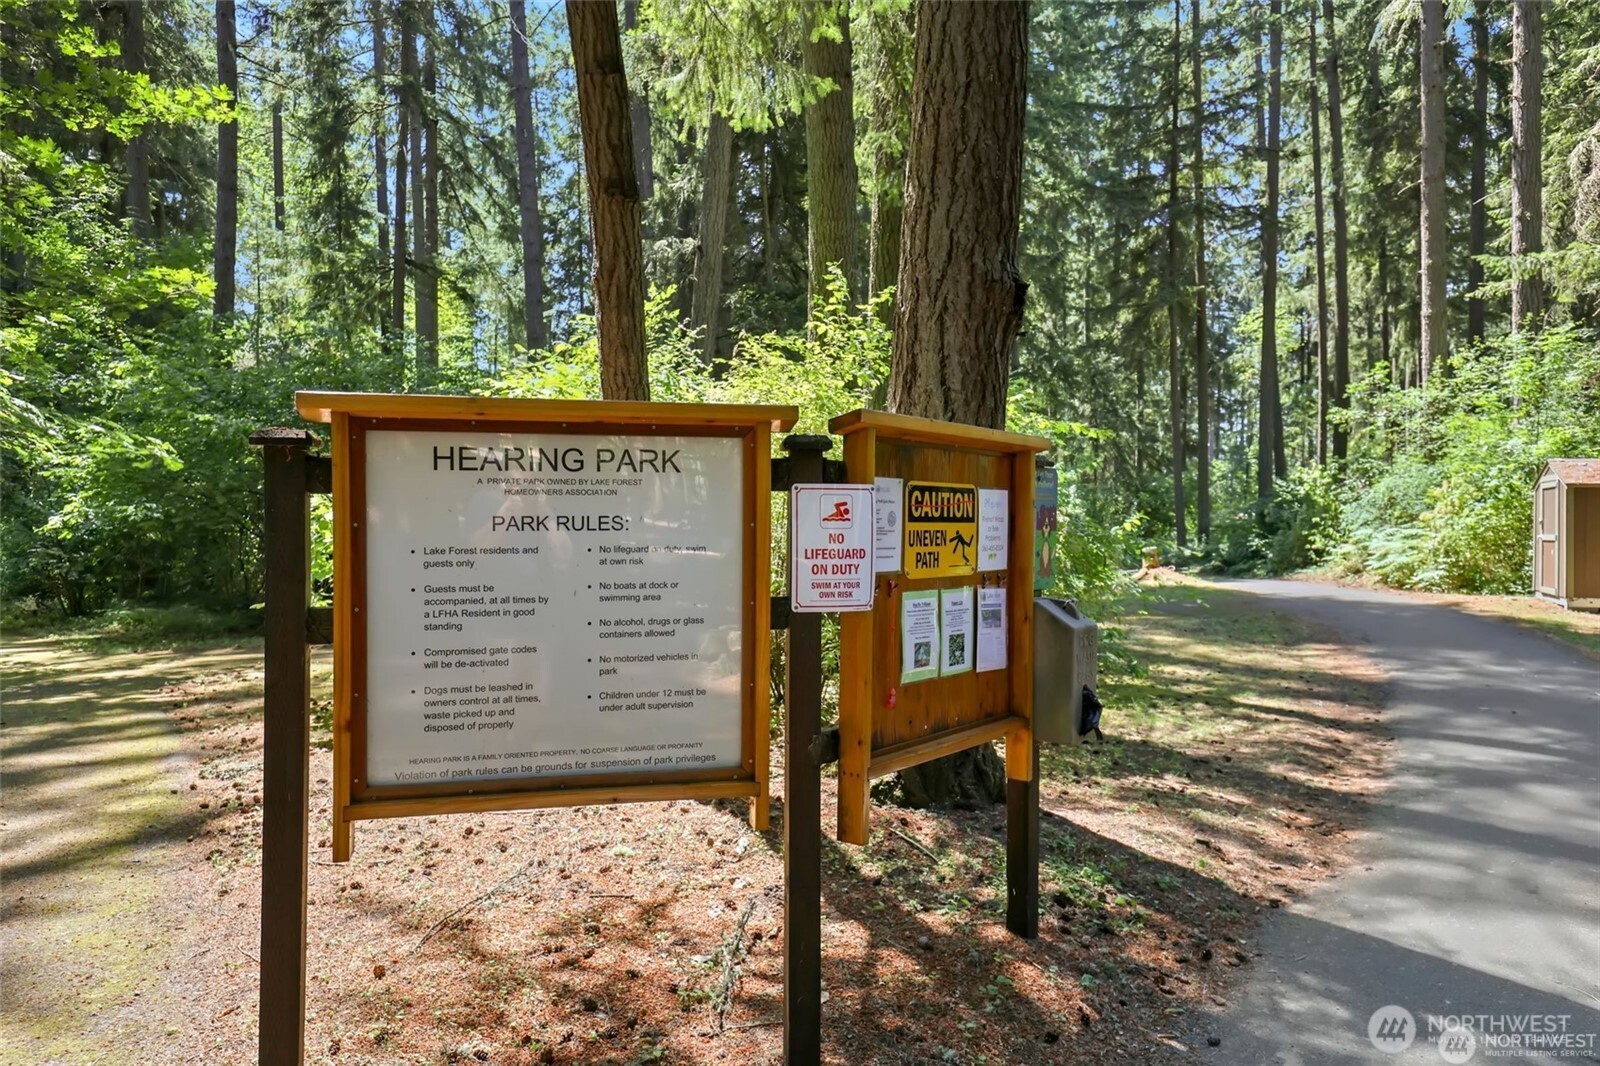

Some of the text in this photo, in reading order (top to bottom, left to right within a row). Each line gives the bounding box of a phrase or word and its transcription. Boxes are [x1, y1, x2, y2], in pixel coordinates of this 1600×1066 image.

[433, 446, 681, 473] HEARING PARK
[487, 478, 521, 486] PRIVATE
[523, 478, 545, 486] PARK
[547, 478, 577, 486] OWNED
[578, 478, 589, 486] BY
[591, 478, 611, 486] LAKE
[911, 490, 973, 518] CAUTION
[492, 516, 629, 531] PARK RULES:
[829, 533, 845, 544] NO
[908, 530, 947, 547] UNEVEN
[424, 547, 446, 555] Lake
[448, 547, 477, 555] Forest
[480, 547, 520, 555] residents
[614, 545, 649, 555] lifeguard
[804, 548, 866, 560] LIFEGUARD
[423, 559, 475, 569] guests only
[600, 557, 644, 566] at own risk
[915, 551, 939, 569] PATH
[811, 564, 860, 575] ON DUTY
[424, 585, 456, 593] Guests
[483, 584, 495, 592] be
[600, 581, 679, 590] No boats at dock or
[600, 594, 641, 603] swimming
[819, 591, 853, 599] OWN RISK
[424, 597, 487, 607] accompanied,
[500, 596, 510, 604] all
[512, 596, 536, 604] times
[538, 596, 549, 605] by
[432, 609, 459, 618] LFHA
[461, 609, 501, 617] Resident
[503, 608, 511, 616] in
[513, 608, 535, 618] good
[424, 623, 463, 632] standing
[600, 617, 705, 627] No alcohol, drugs or glass
[600, 629, 675, 639] containers allowed
[424, 645, 537, 657] Compromised gate codes
[424, 658, 509, 669] will be de-activated
[614, 655, 655, 663] motorized
[657, 653, 690, 661] vehicles
[600, 668, 618, 677] park
[424, 682, 533, 696] Dogs must be leashed in
[600, 688, 707, 700] Children under 12 must be
[424, 700, 457, 708] owners
[459, 697, 490, 706] control
[492, 697, 501, 705] at
[503, 696, 513, 704] all
[600, 700, 694, 712] under adult supervision
[424, 708, 515, 720] waste picked up and
[424, 720, 514, 733] disposed of properly
[620, 745, 655, 753] LANGUAGE
[395, 754, 717, 781] Violation of park rules can be grounds for suspension of park privileges
